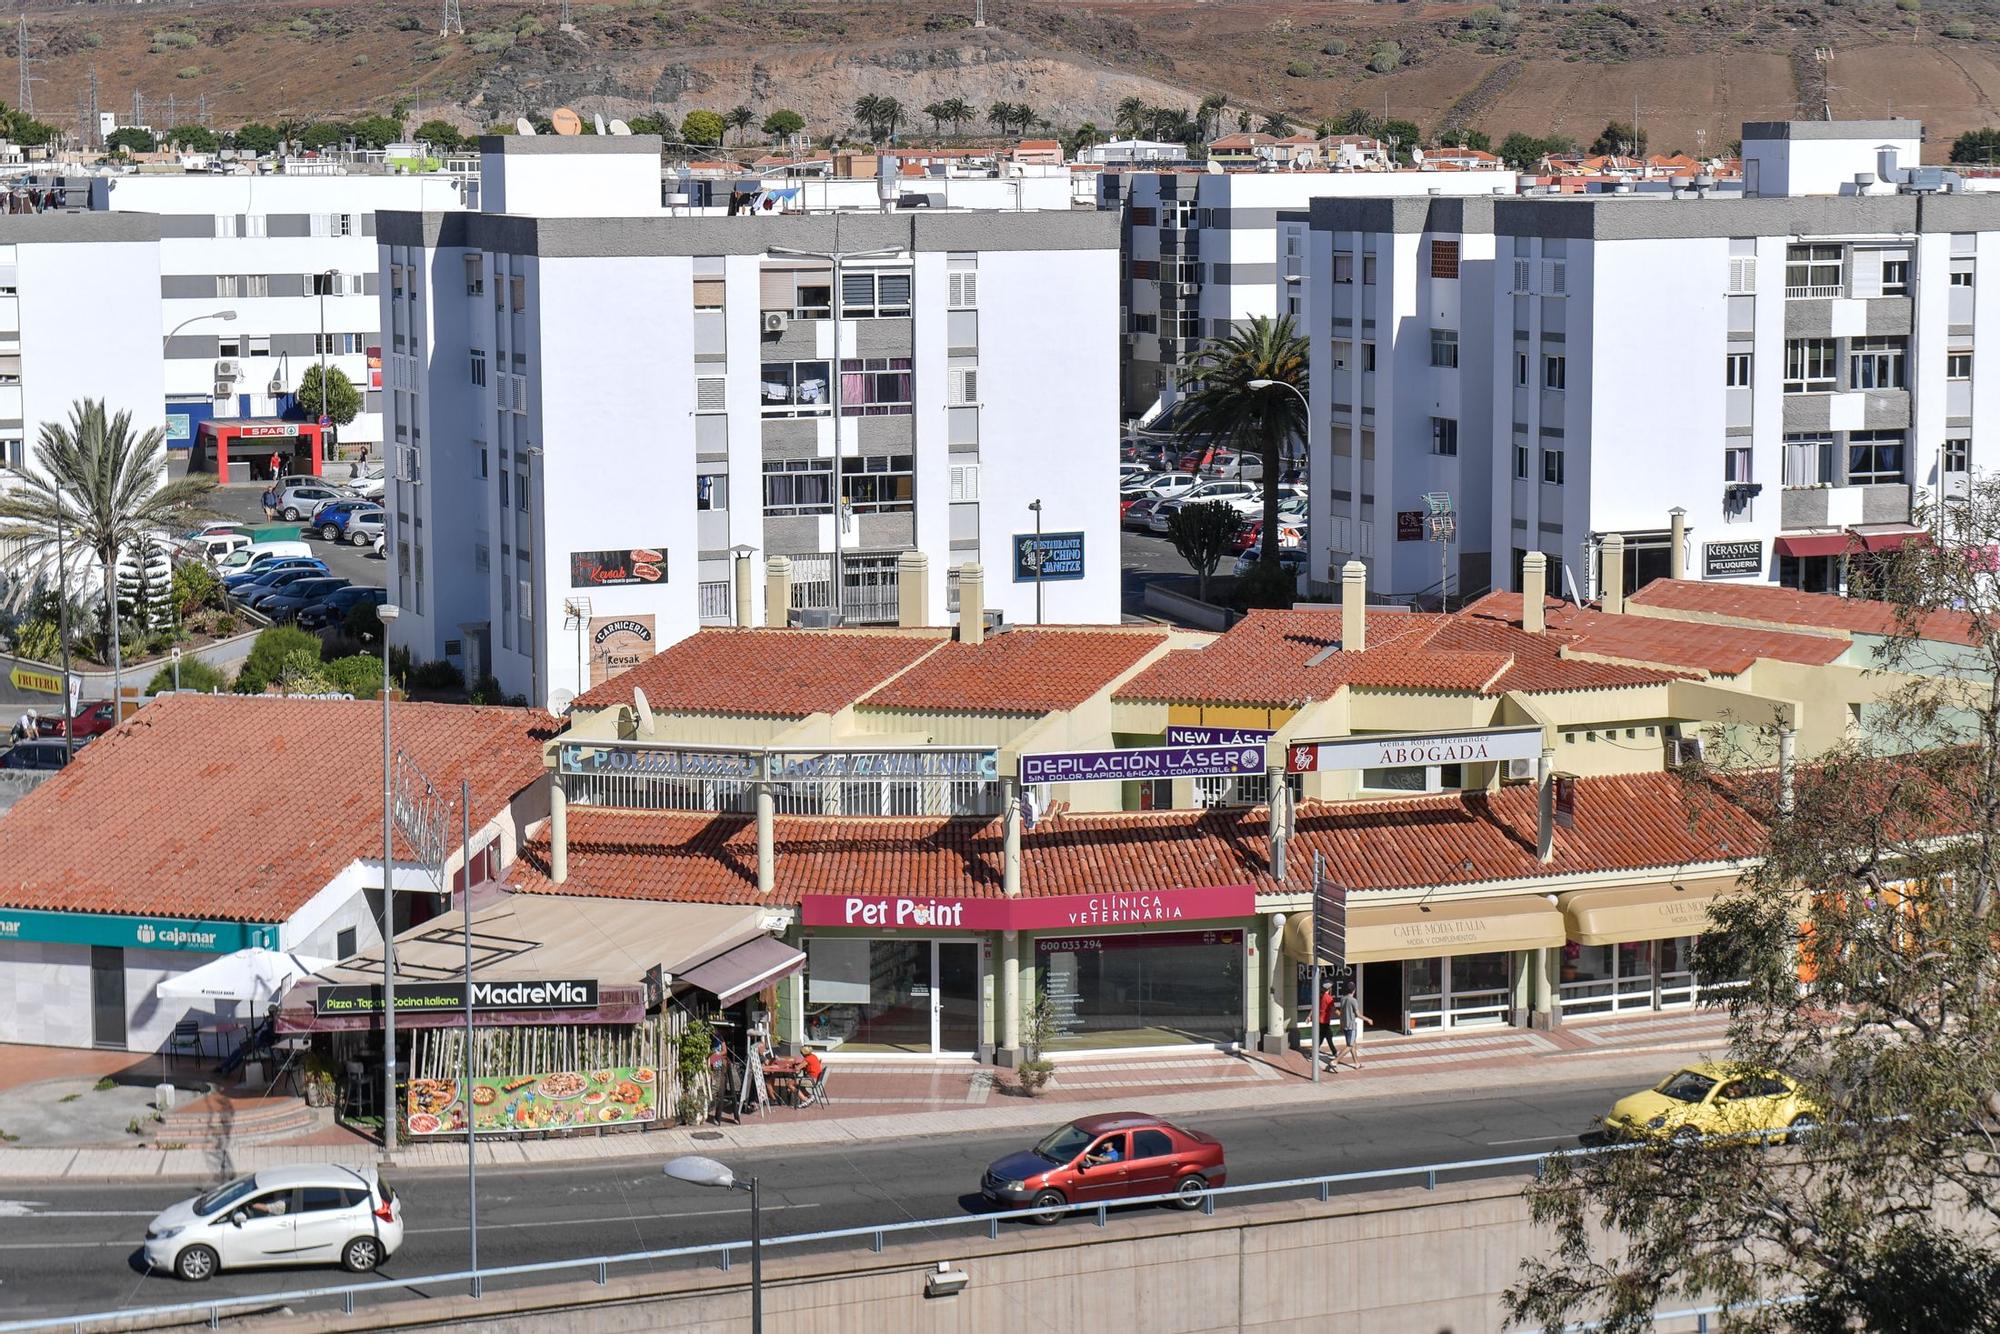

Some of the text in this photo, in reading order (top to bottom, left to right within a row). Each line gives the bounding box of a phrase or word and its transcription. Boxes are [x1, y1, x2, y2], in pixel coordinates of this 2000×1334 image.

[251, 427, 285, 436] SPAR
[1053, 549, 1081, 561] CHINO
[1042, 561, 1081, 572] JANGTZE
[1171, 731, 1210, 744] NEW
[1410, 738, 1436, 747] Rojas
[1380, 744, 1488, 764] ABOGADA
[1027, 749, 1239, 774] DEPILACIÓN LÁSER
[1170, 767, 1230, 776] COMPATIBLE
[1089, 895, 1162, 911] CLÍNICA
[845, 898, 888, 925] Pet
[1069, 907, 1182, 924] VETERINARIA
[159, 927, 216, 946] cajamar
[1040, 939, 1102, 951] 600 033 294
[1298, 963, 1352, 980] REAJAS
[471, 982, 587, 1005] MadreMia
[326, 999, 352, 1009] Pizza
